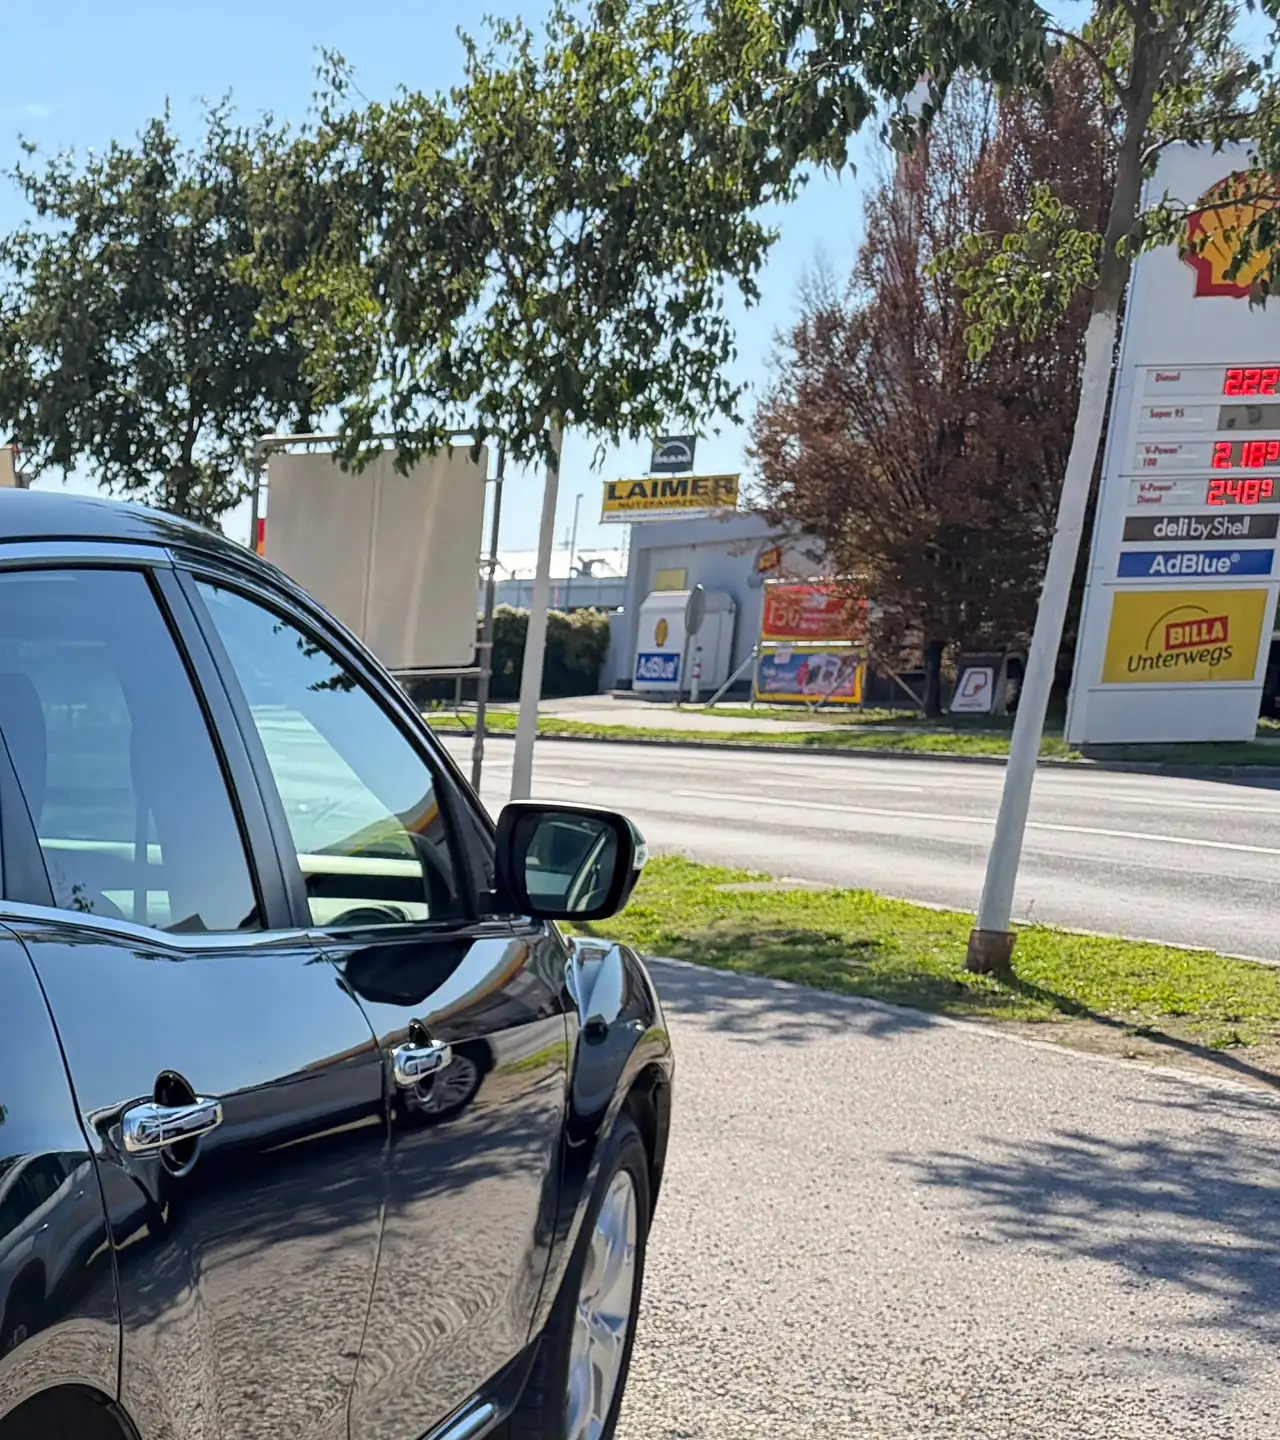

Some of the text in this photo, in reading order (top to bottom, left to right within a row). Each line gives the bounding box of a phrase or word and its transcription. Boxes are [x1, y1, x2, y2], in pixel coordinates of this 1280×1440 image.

[1149, 407, 1185, 420] Super 95
[607, 477, 735, 501] LAIMER
[1153, 516, 1251, 540] deli by Shell
[1168, 621, 1225, 647] BILLA
[1127, 644, 1233, 674] Unterwegs
